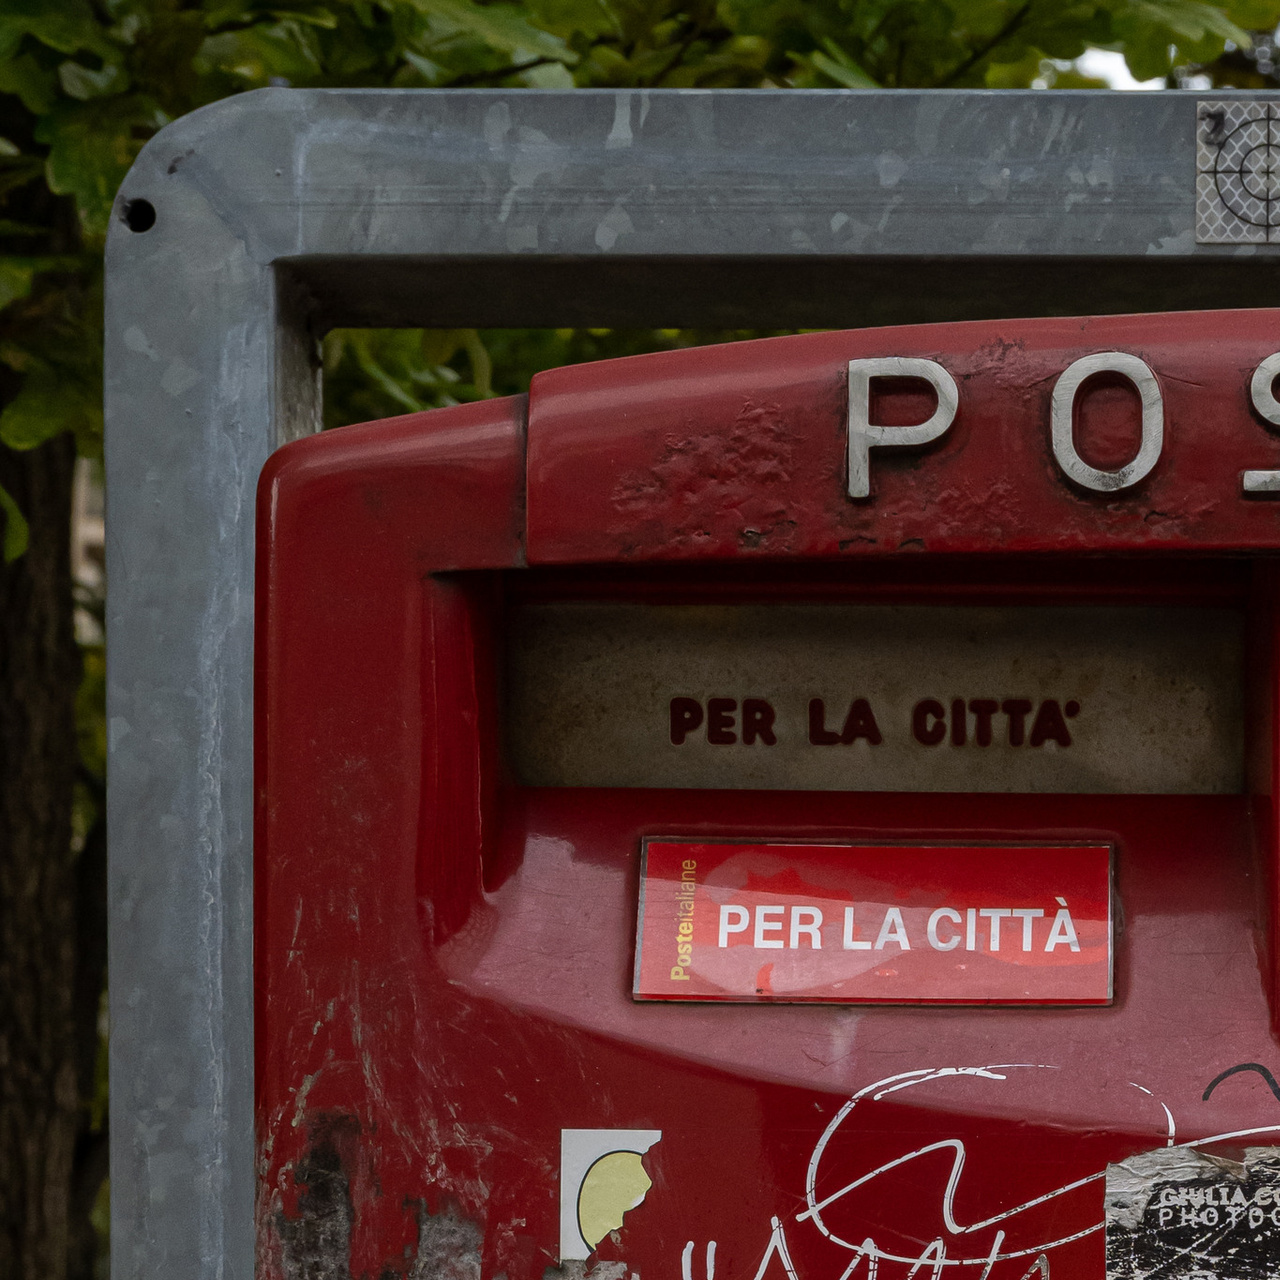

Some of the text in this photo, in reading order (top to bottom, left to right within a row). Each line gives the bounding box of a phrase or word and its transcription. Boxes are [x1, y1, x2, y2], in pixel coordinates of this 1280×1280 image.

[669, 697, 777, 746] PER
[808, 698, 883, 746] LA
[670, 859, 697, 980] Posteitaliane
[717, 897, 1081, 952] PER LA CITTÀ
[1159, 1187, 1246, 1207] GIULIA
